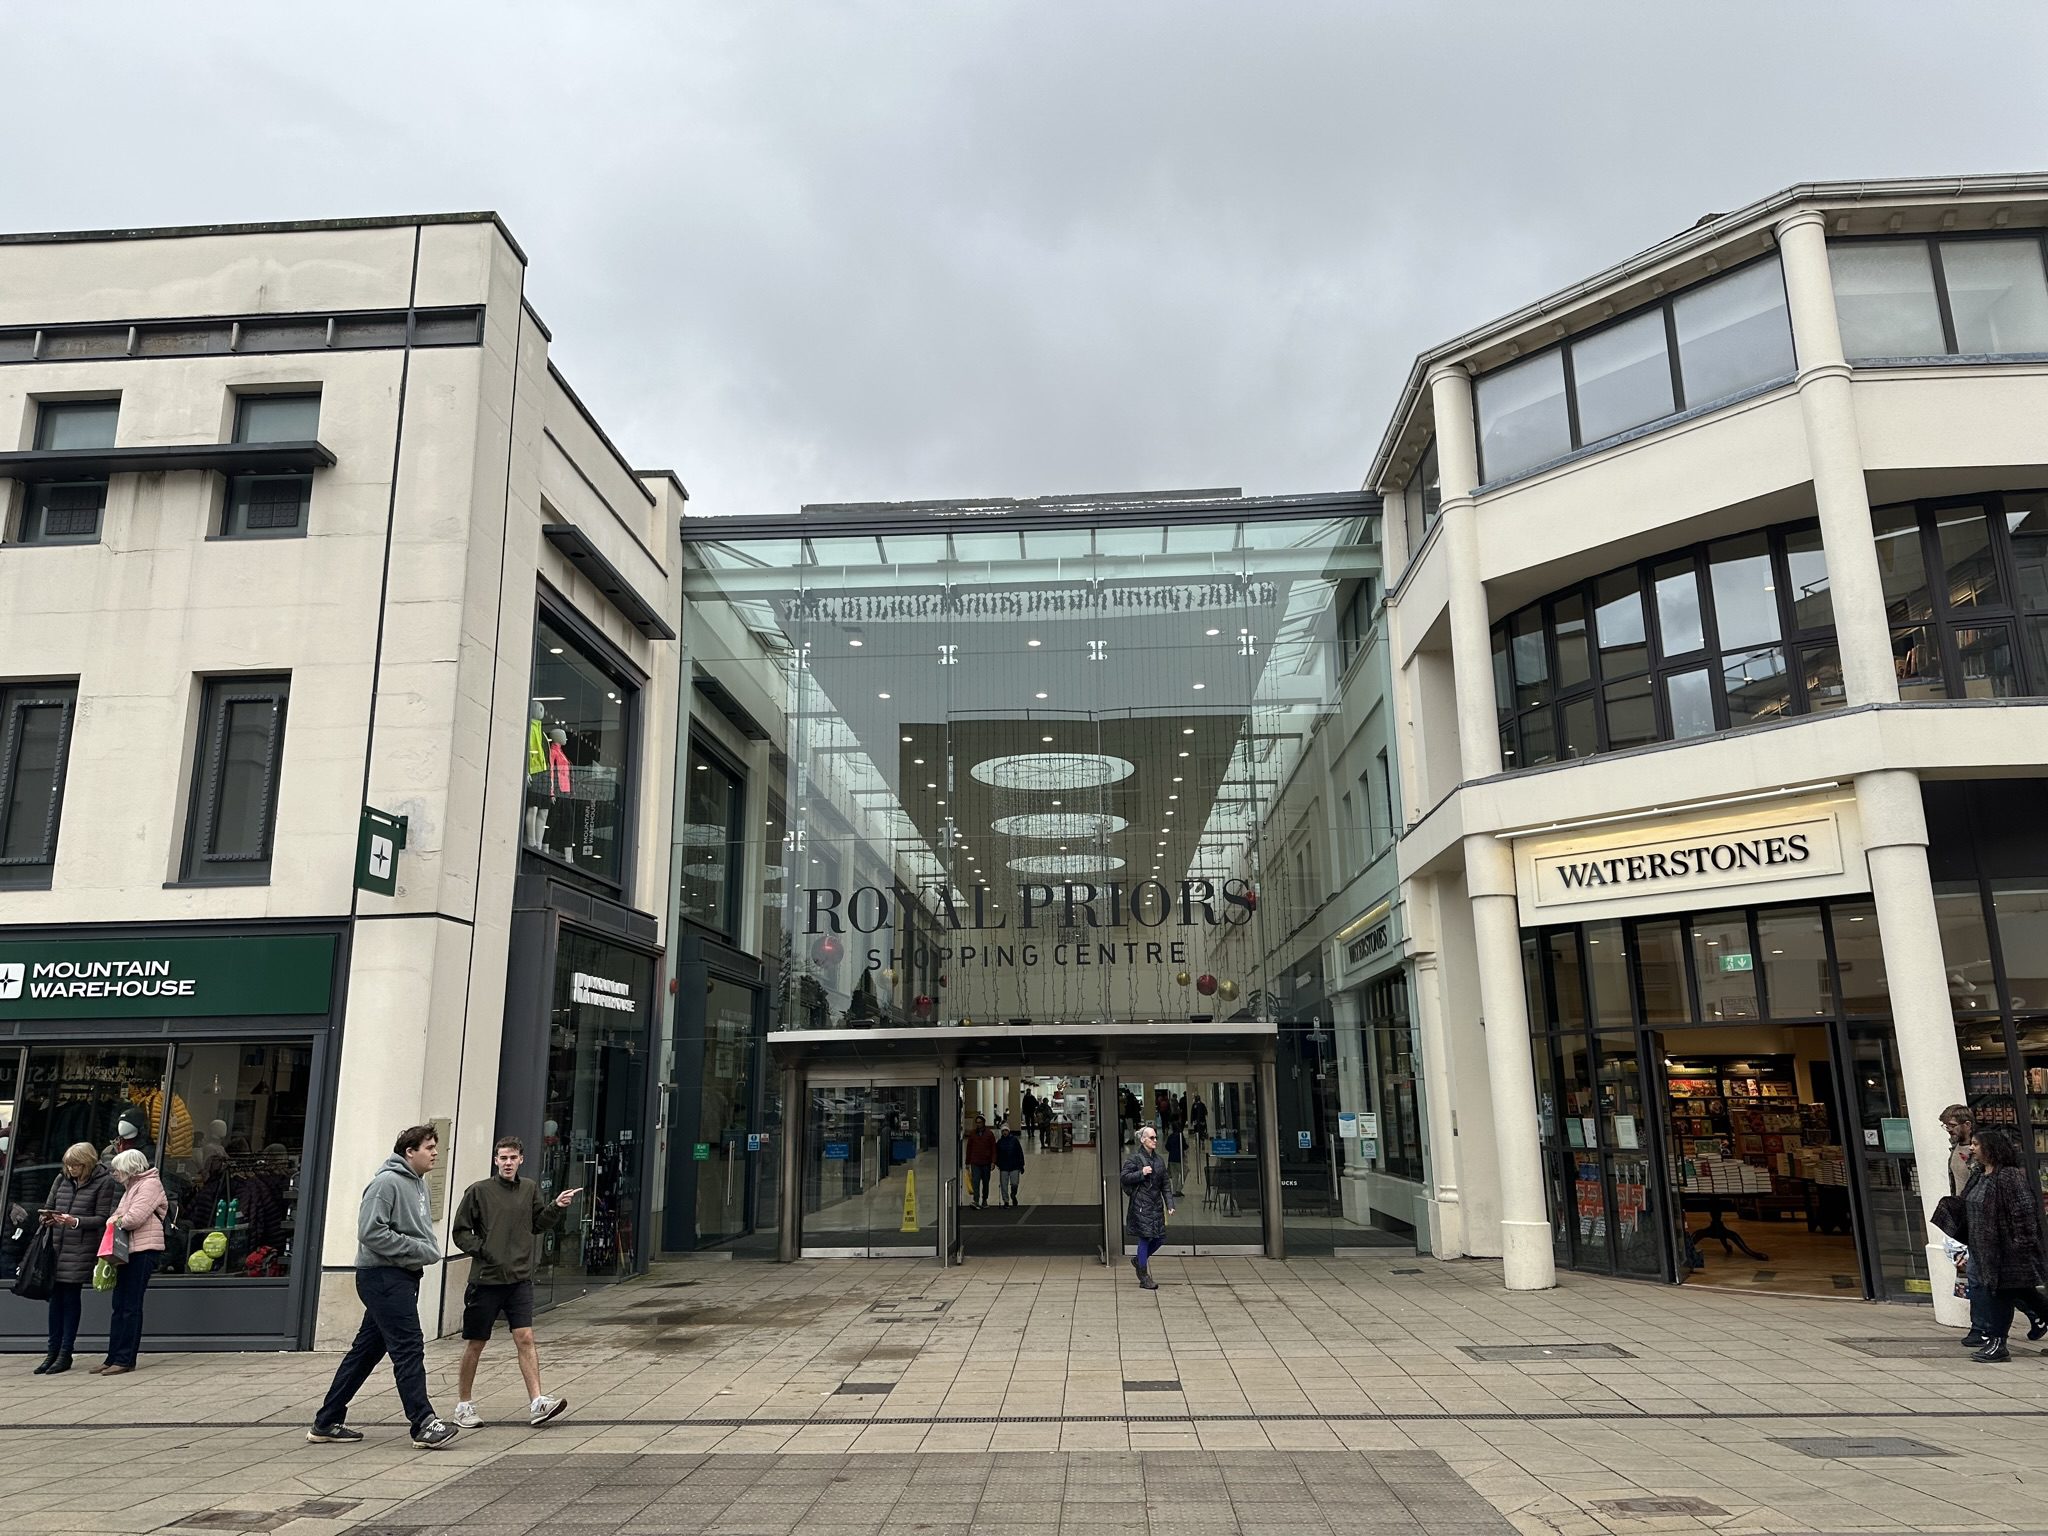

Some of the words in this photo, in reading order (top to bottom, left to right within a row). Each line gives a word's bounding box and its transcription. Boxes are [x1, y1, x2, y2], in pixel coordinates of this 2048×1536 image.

[1556, 834, 1810, 889] WATERSTONES
[802, 884, 1007, 934] ROYAL
[1017, 878, 1254, 930] PRIORS
[33, 960, 170, 979] MOUNTAIN
[866, 944, 1039, 971] SHOPPING
[1053, 941, 1186, 967] CENTRE
[30, 979, 196, 999] WAREHOUSE
